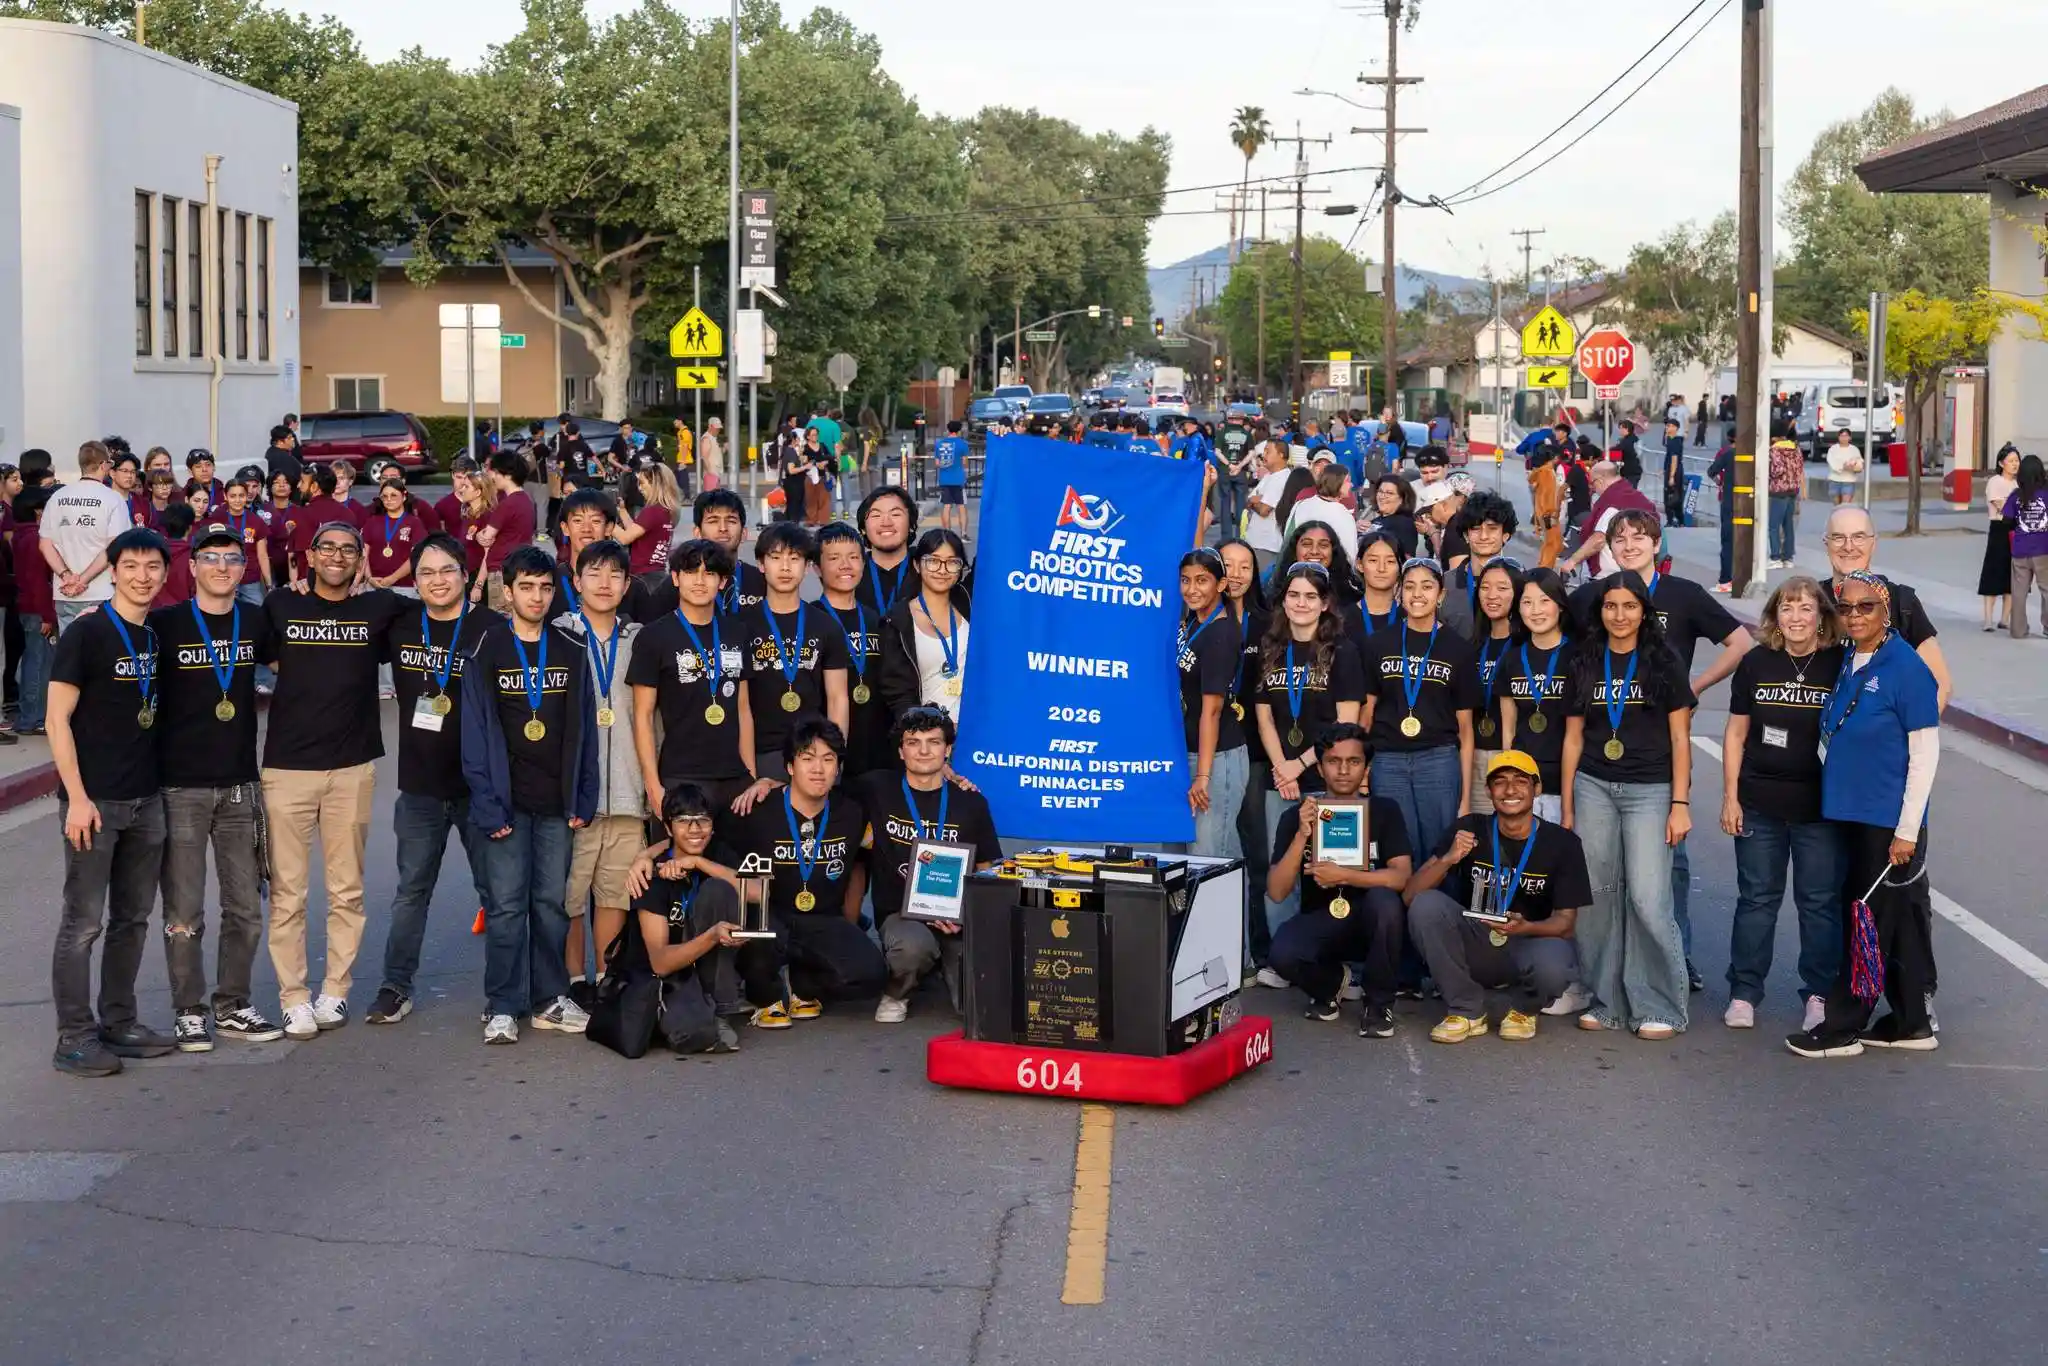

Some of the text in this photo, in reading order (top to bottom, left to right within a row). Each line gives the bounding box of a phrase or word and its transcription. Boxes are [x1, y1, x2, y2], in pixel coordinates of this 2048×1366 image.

[750, 229, 767, 239] Class
[755, 241, 763, 251] of
[1582, 346, 1630, 369] STOP
[1332, 374, 1348, 384] 25
[58, 498, 102, 507] VOLUNTEER
[76, 518, 96, 526] AGE
[1049, 529, 1126, 561] FIRST
[1030, 550, 1143, 584] ROBOTICS
[1007, 570, 1162, 608] COMPETITION
[287, 625, 368, 640] QUIXILVER
[528, 666, 539, 674] 60
[1027, 651, 1129, 679] WINNER
[1380, 660, 1451, 680] QUIIVER
[499, 673, 568, 689] QUILVER
[1048, 706, 1101, 724] 2026
[1049, 739, 1098, 754] FIRST
[973, 751, 1174, 774] CALIFORNIA DISTRICT
[1020, 774, 1125, 791] PINNACLES
[1041, 795, 1102, 809] EVENT
[1073, 966, 1093, 975] arm
[1061, 994, 1096, 1004] fabworks
[1246, 1030, 1270, 1067] 604
[1017, 1057, 1083, 1092] 604
